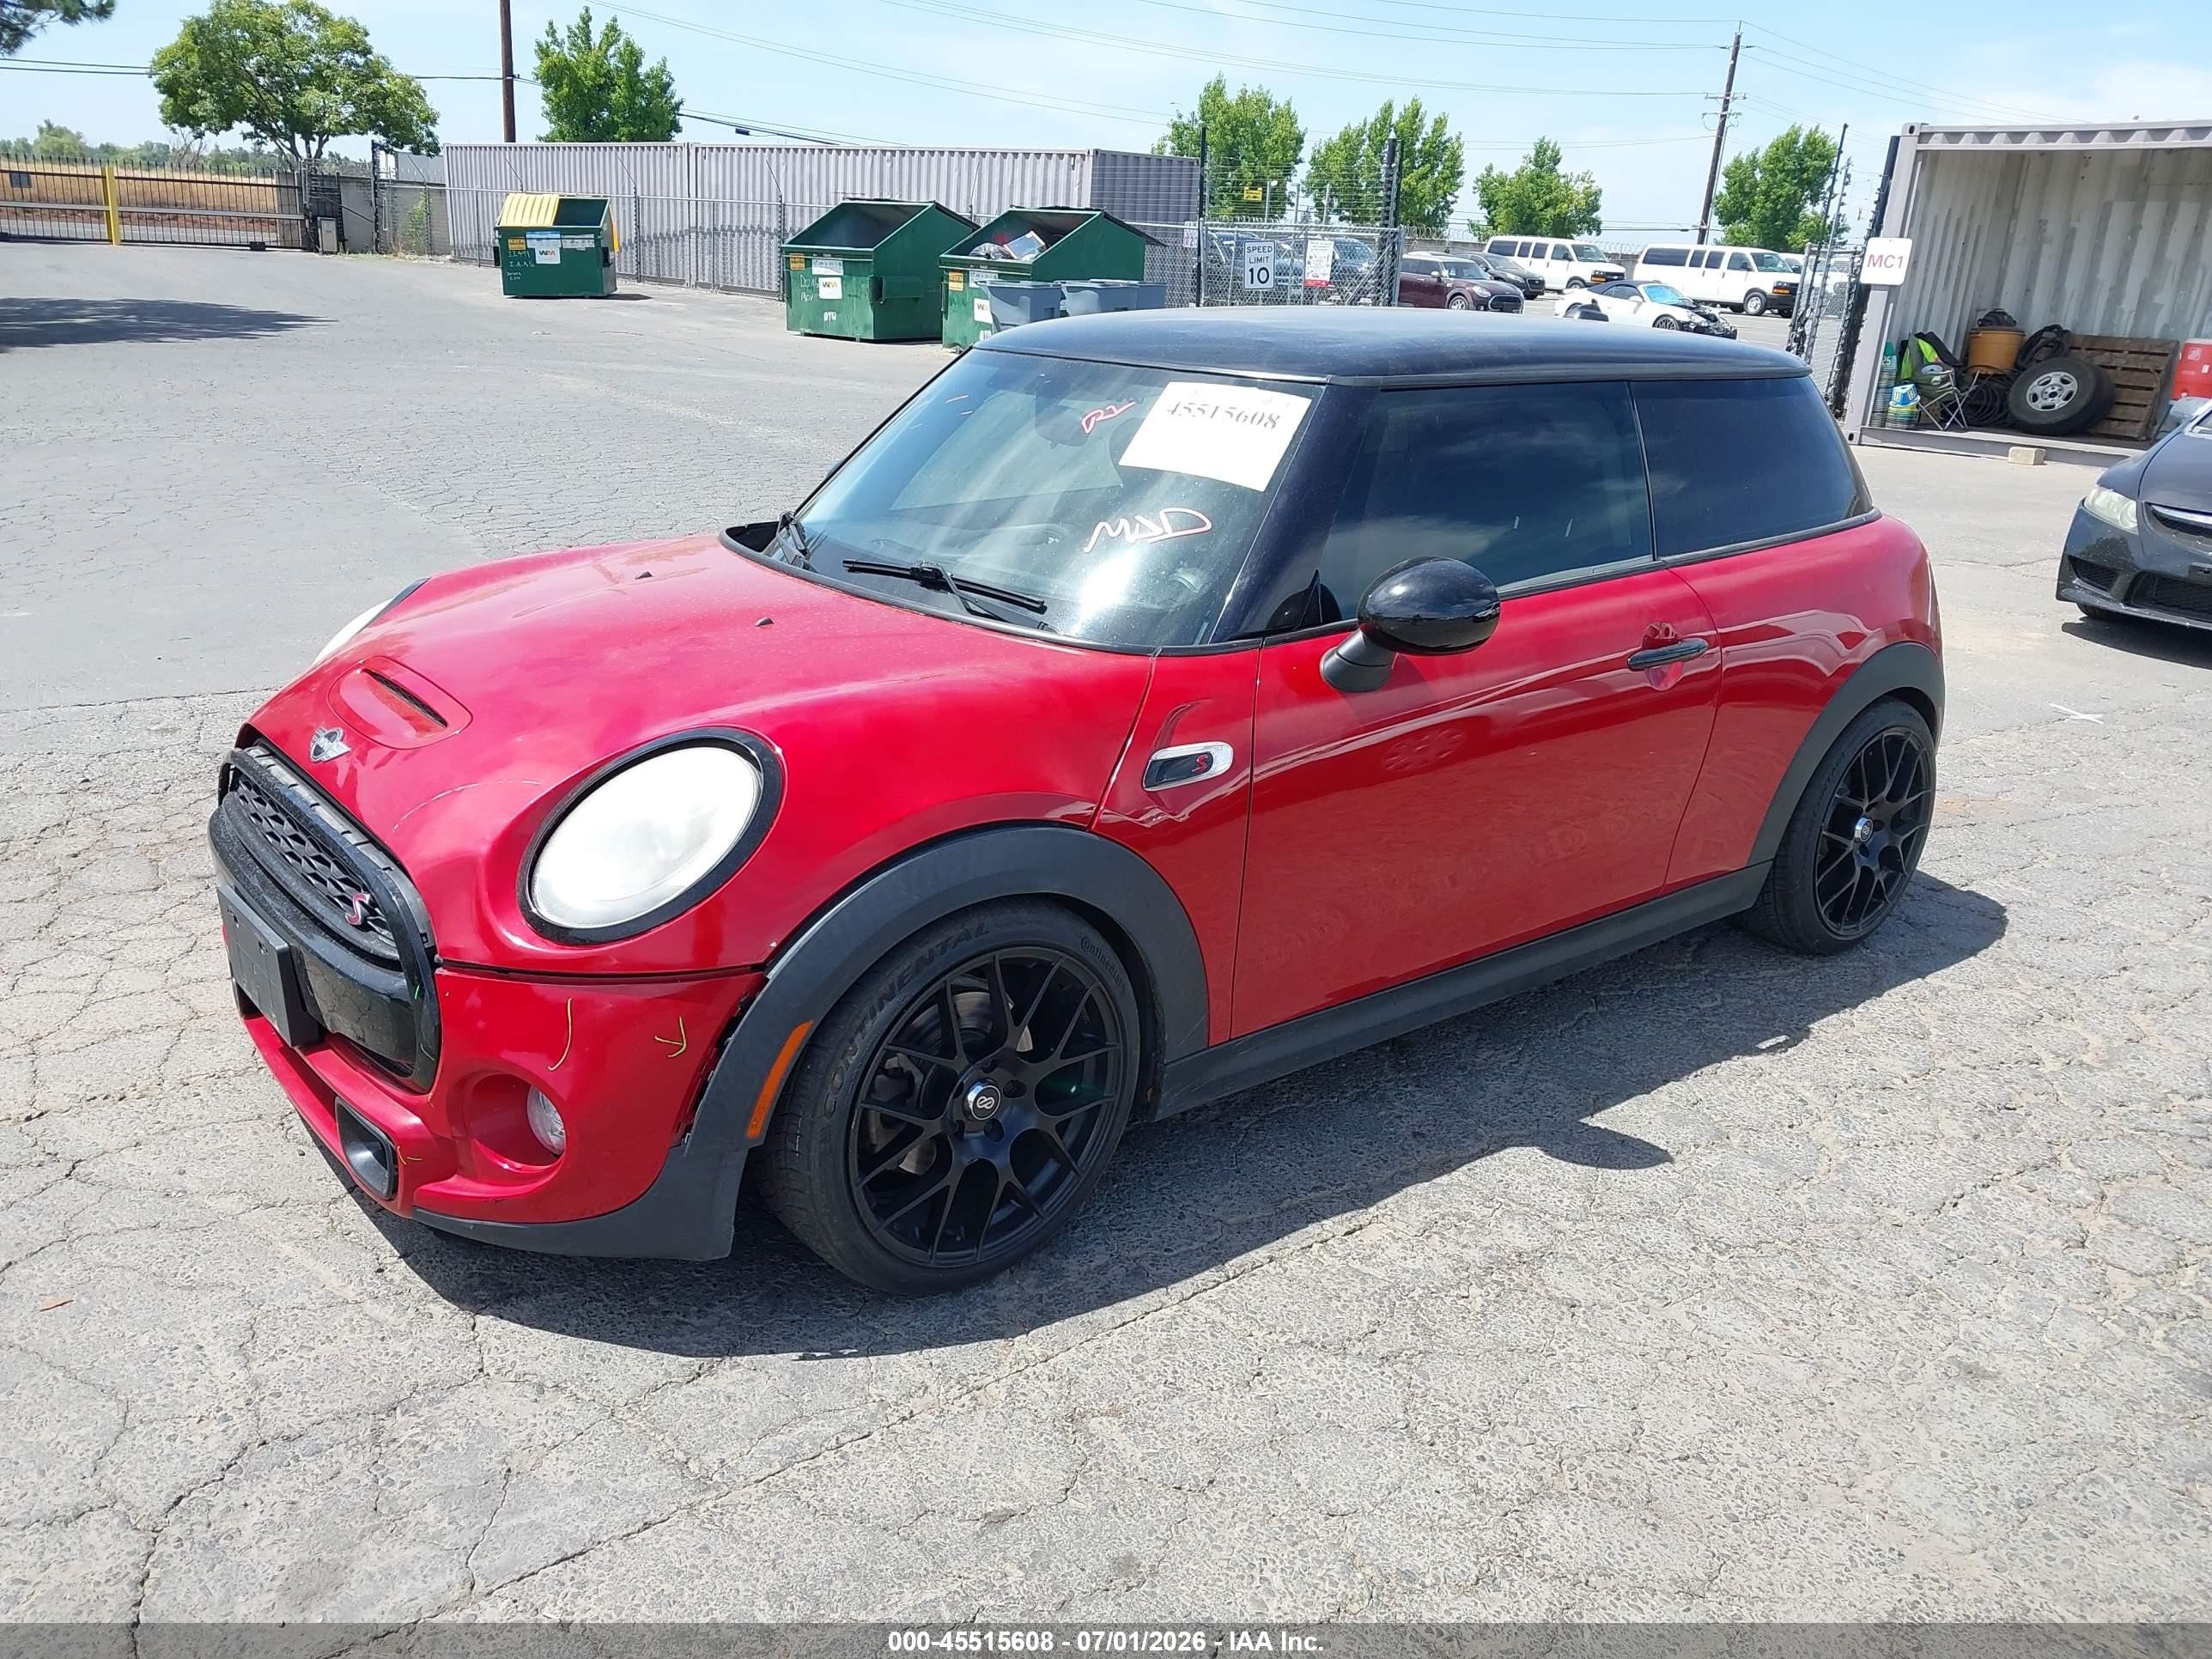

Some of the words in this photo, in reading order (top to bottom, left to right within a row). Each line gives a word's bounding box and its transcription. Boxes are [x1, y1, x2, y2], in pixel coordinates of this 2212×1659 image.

[1868, 254, 1903, 268] MC1
[1249, 266, 1269, 284] 10
[1167, 402, 1280, 429] 45515608
[1192, 755, 1208, 773] S
[345, 893, 369, 927] S
